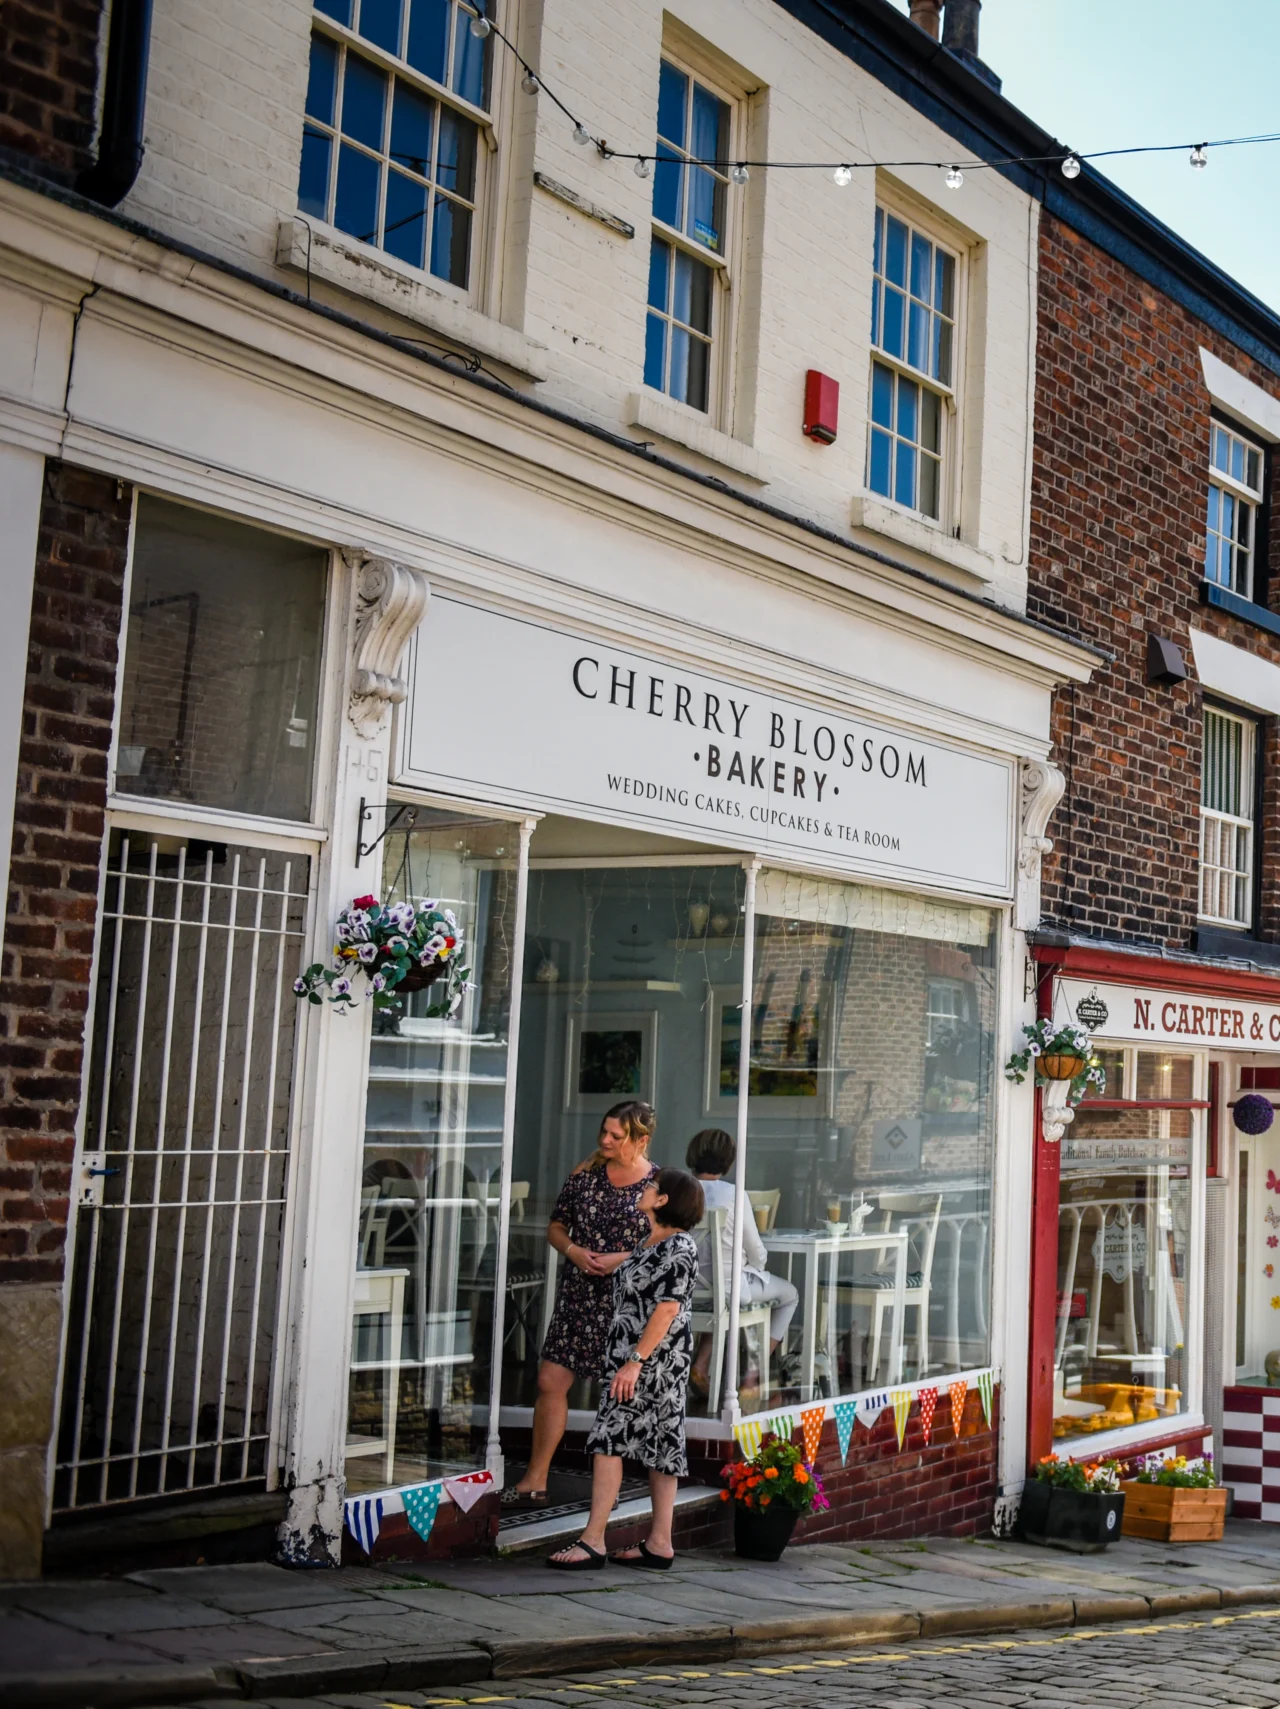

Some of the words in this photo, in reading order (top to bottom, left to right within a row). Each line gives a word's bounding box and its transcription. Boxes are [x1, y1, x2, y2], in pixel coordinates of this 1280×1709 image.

[572, 656, 750, 739] CHERRY
[770, 711, 928, 788] BLOSSOM
[607, 773, 689, 807] WEDDING
[694, 793, 744, 821] CAKES,
[750, 805, 820, 834] CUPCAKES
[823, 821, 834, 837] &
[837, 824, 860, 843] TEA
[864, 830, 900, 851] ROOM
[1133, 998, 1155, 1031] N.
[1161, 1001, 1245, 1039] CARTER
[1250, 1012, 1264, 1041] &
